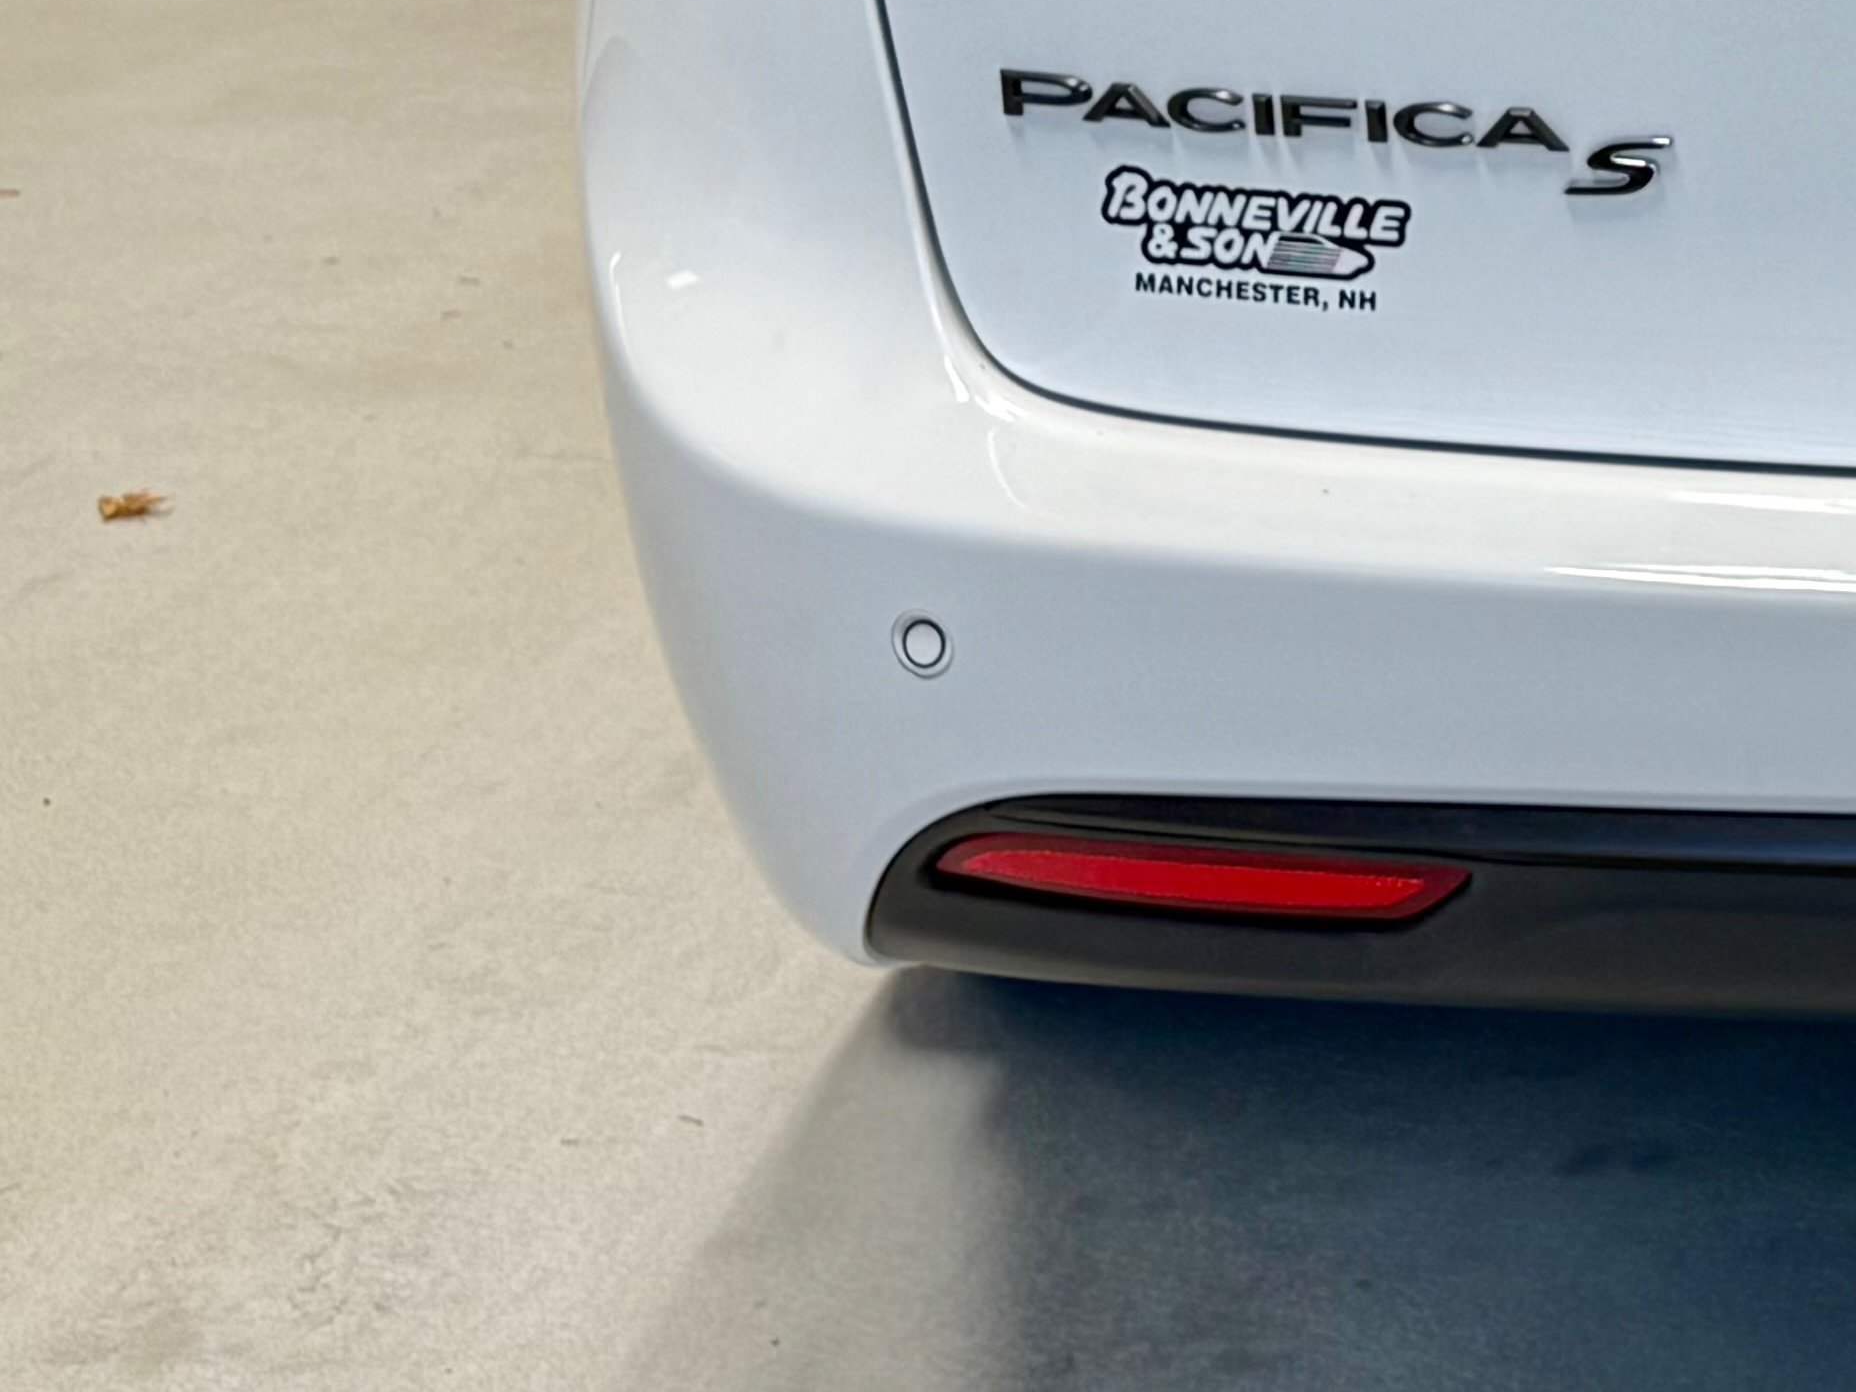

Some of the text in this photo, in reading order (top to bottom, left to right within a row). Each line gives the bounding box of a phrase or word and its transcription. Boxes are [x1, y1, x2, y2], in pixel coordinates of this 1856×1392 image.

[1000, 68, 1673, 195] PACIFICA S
[1104, 170, 1408, 242] BONNEVILLE
[1135, 273, 1376, 311] MANCHESTER, NH
